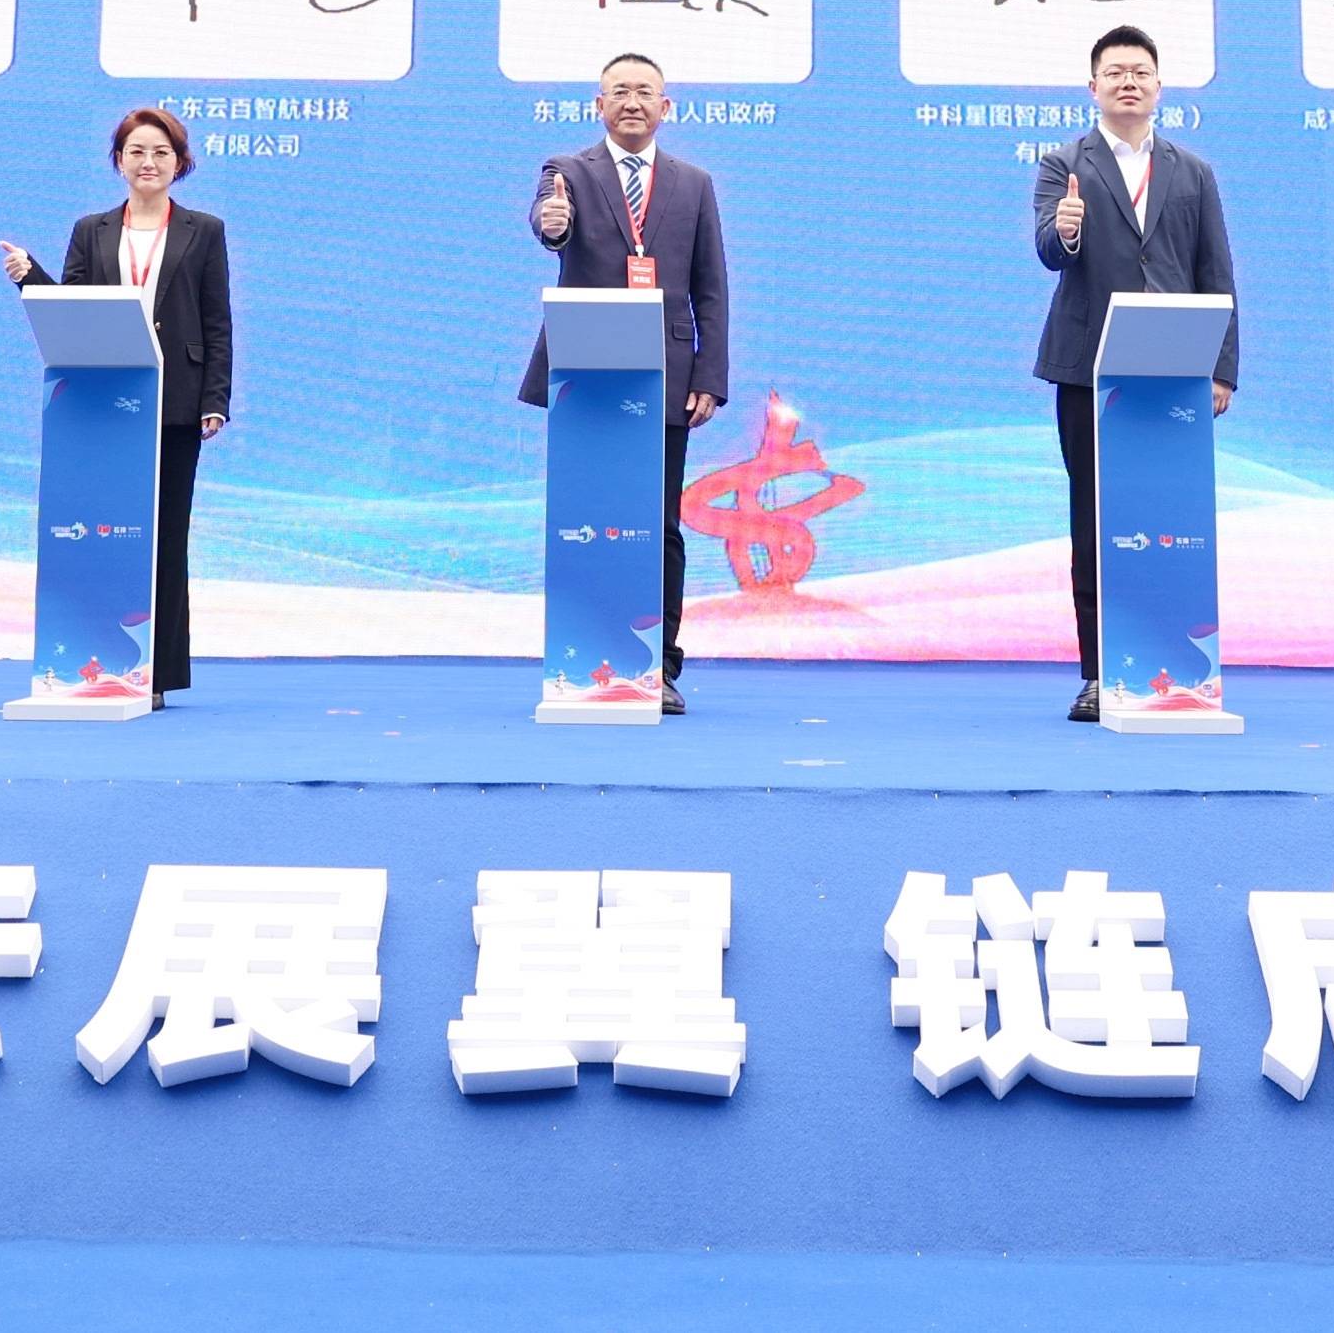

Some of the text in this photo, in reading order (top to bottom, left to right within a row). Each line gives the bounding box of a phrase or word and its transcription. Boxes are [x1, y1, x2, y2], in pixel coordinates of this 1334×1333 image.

[158, 97, 350, 121] 广东云百智航科技
[204, 133, 300, 157] 有限公司
